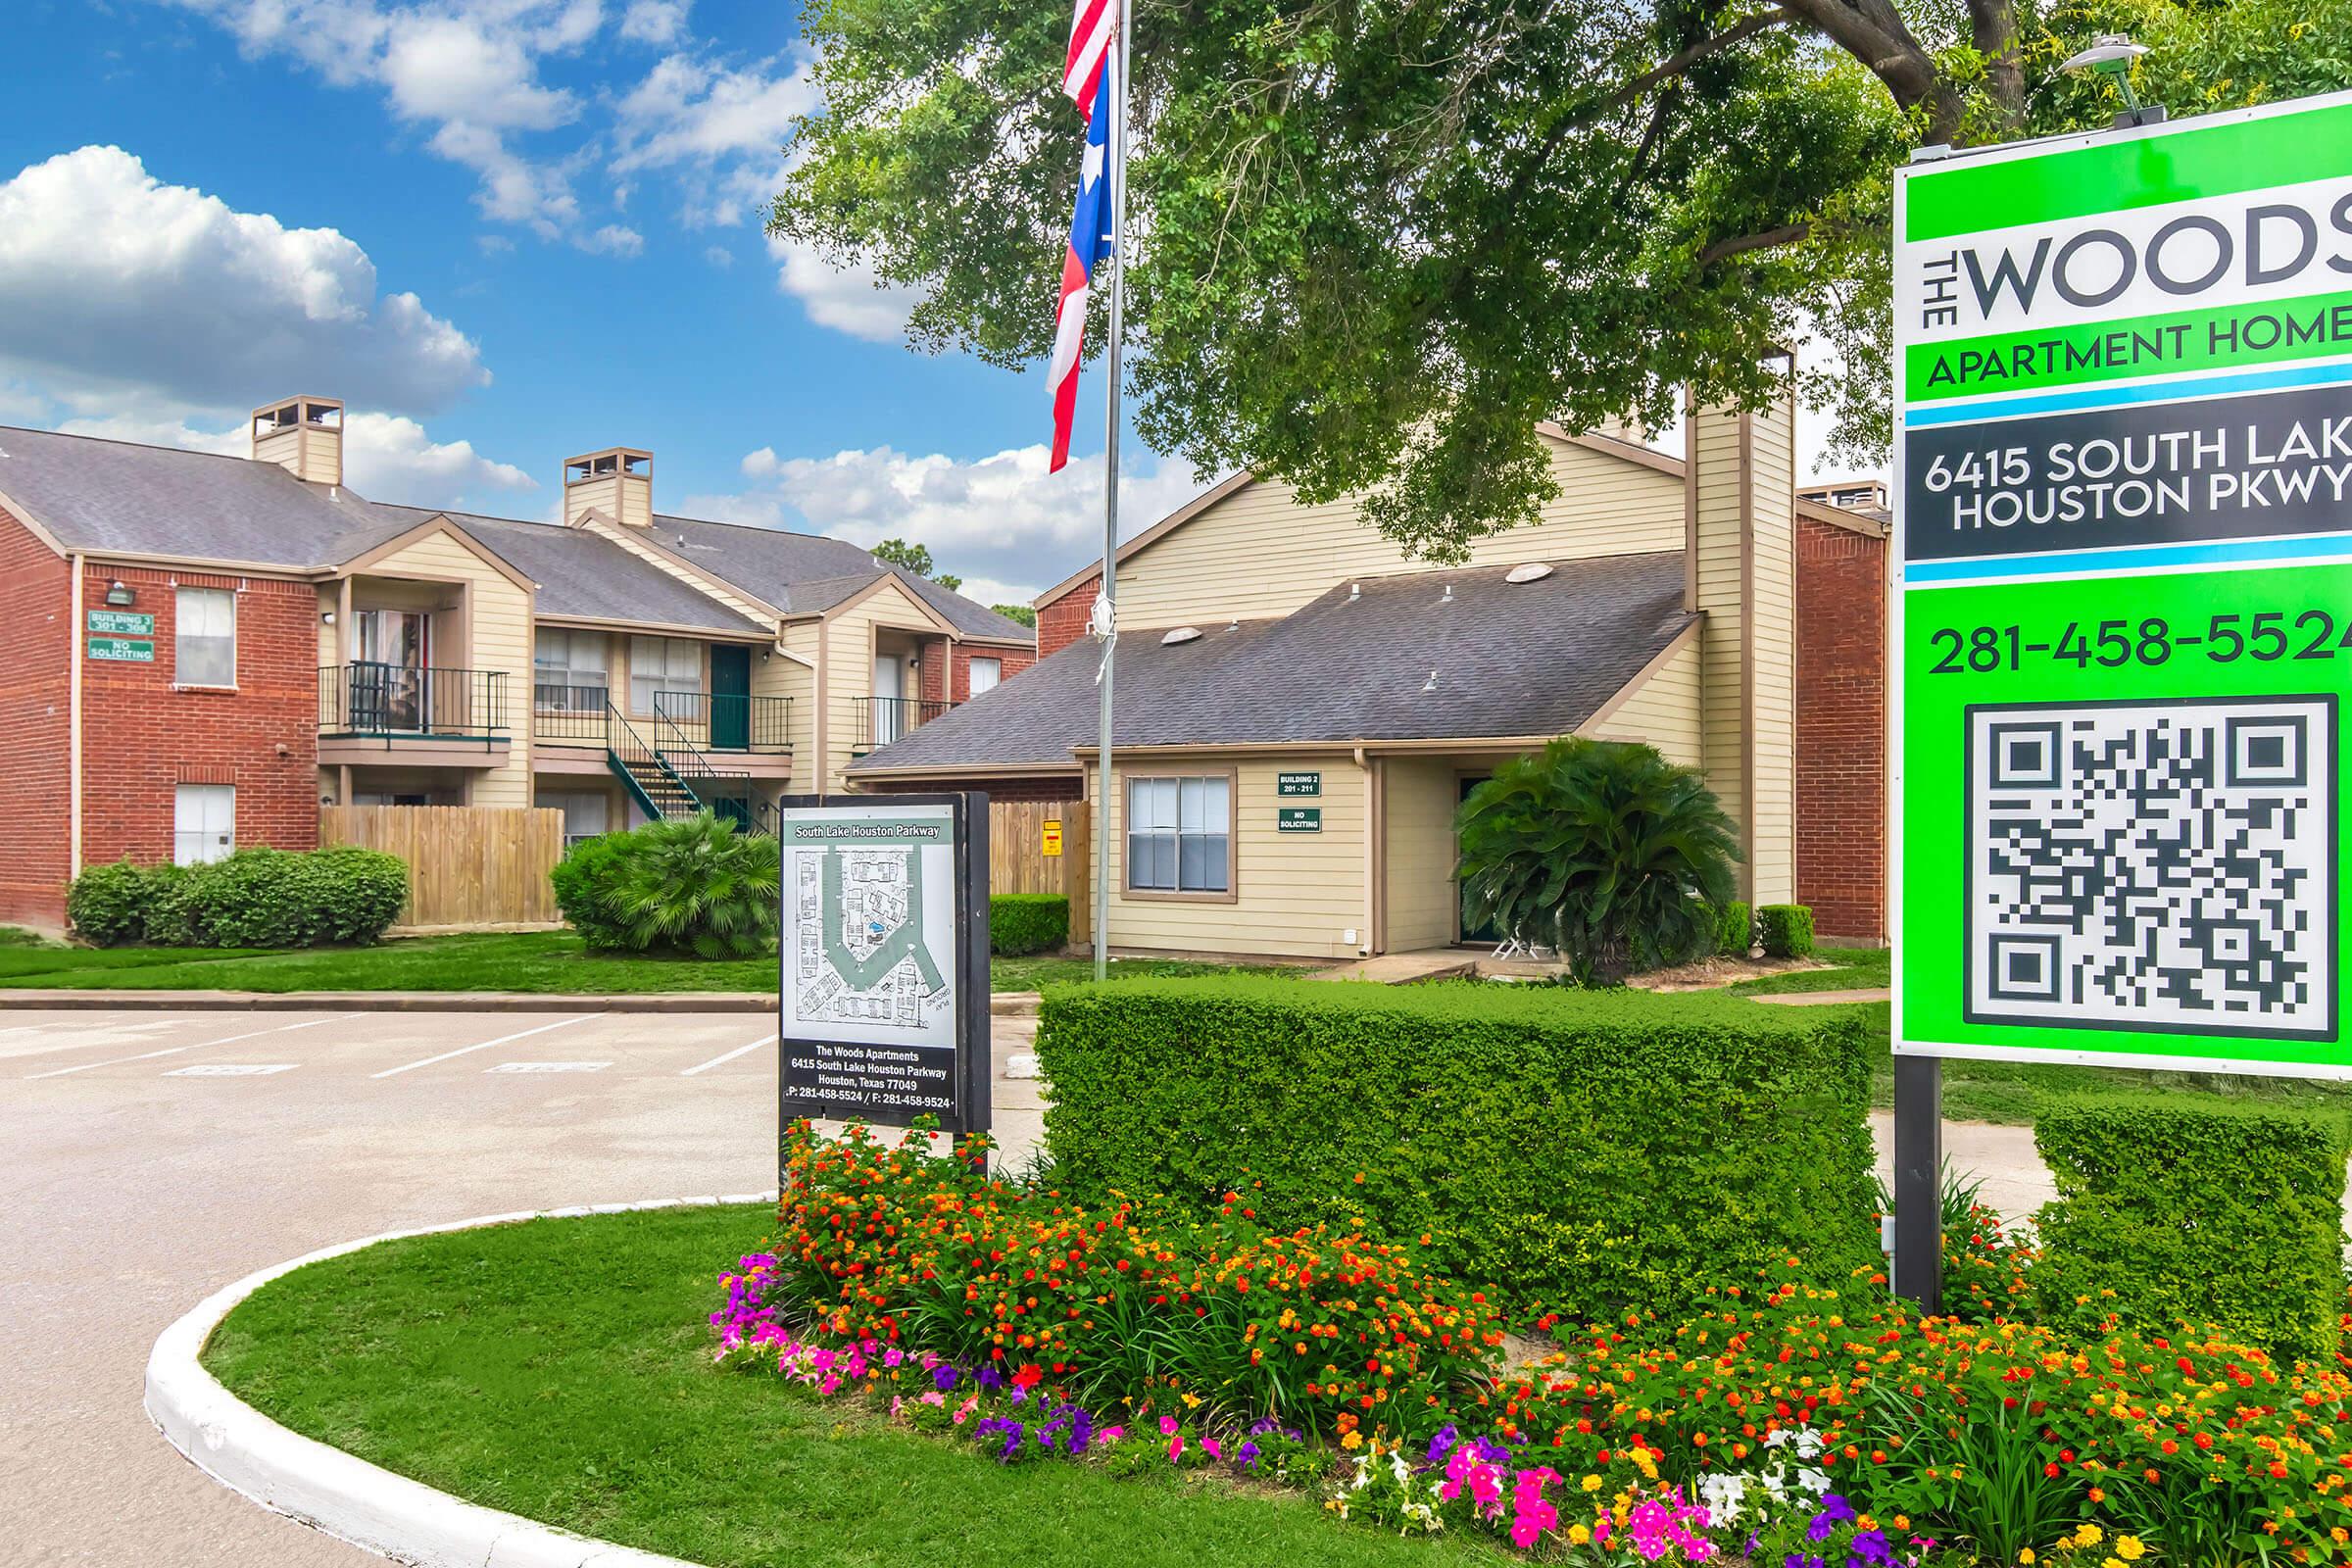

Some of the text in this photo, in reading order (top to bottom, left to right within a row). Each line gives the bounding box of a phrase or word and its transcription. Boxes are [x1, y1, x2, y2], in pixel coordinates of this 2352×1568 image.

[1923, 250, 1958, 330] THE
[1926, 324, 2192, 388] APARTMENT
[1925, 447, 2032, 493] 6415
[2047, 421, 2226, 482] SOUTH
[1953, 463, 2352, 530] HOUSTON PKWY
[91, 613, 142, 624] BUILDING
[95, 621, 116, 630] 301
[91, 648, 152, 660] SOLICITING
[796, 824, 940, 839] South Lake Houston Parkway
[815, 1045, 919, 1061] The Woods Apartments
[791, 1057, 947, 1081] 6415 South Lake Houston Parkway
[818, 1073, 917, 1091] Houston, Texas 77049
[799, 1086, 862, 1102] 281-458-5524
[872, 1093, 881, 1103] F:
[883, 1093, 950, 1108] 281-458-9524
